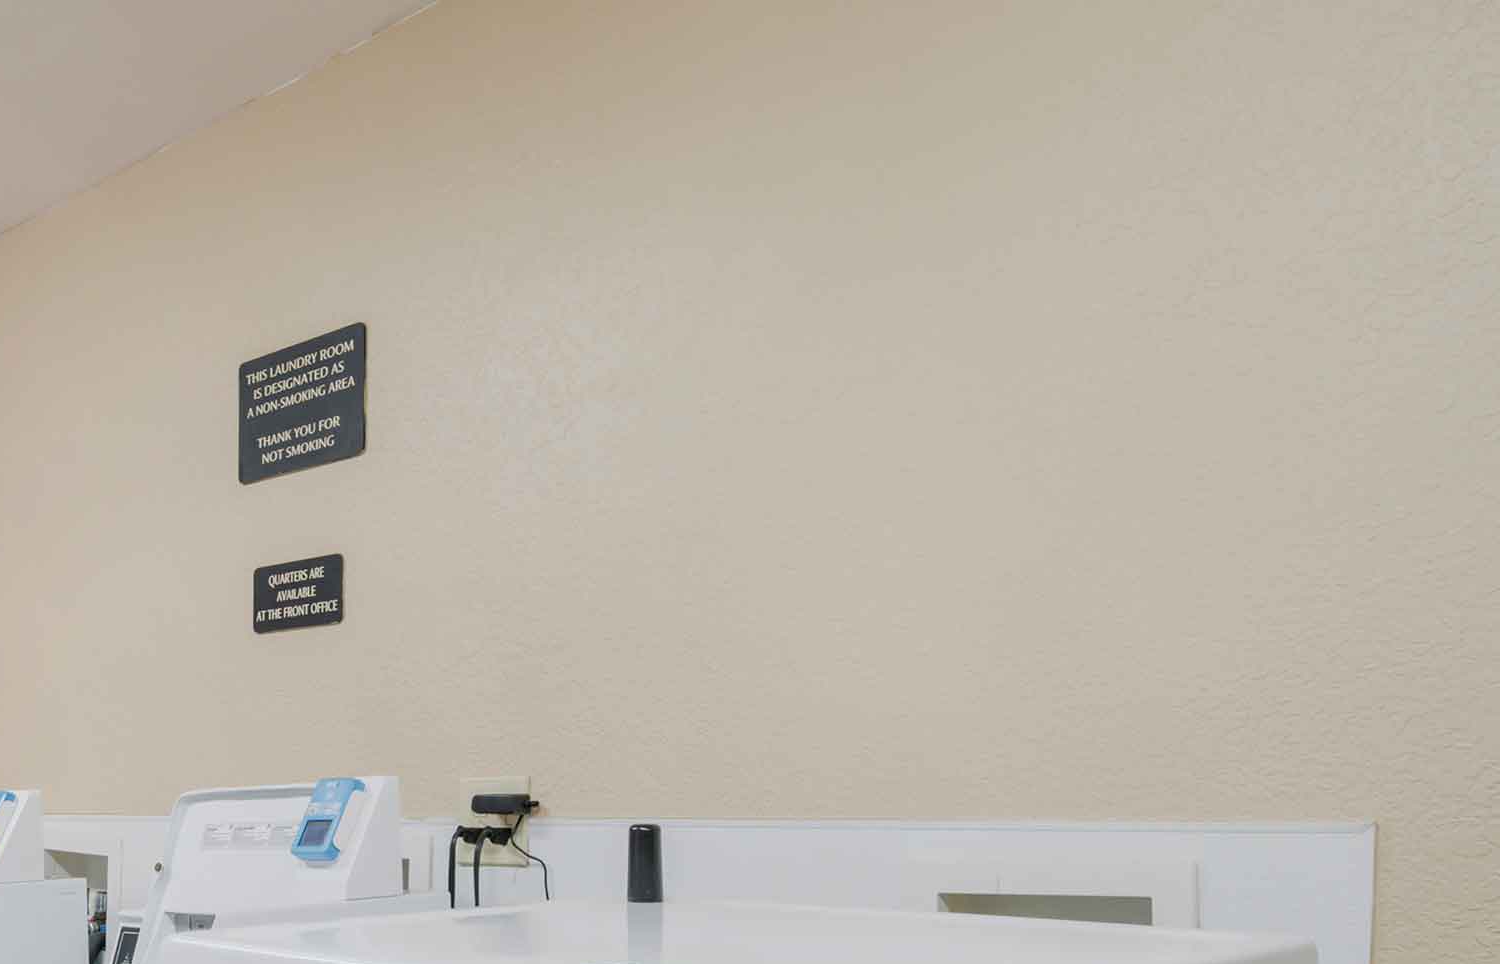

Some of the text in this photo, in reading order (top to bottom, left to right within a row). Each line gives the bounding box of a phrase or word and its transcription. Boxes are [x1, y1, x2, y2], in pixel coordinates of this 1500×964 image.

[246, 339, 353, 385] THIS LAUNDRY ROOM
[253, 360, 344, 400] IS DESIGNATED AS
[246, 375, 355, 418] A NON-SMOKING AREA
[257, 415, 340, 448] THANK YOU FOR
[261, 434, 334, 465] NOT SMOKING
[268, 566, 324, 587] QUARTERS ARE
[276, 585, 316, 602] AVAILABLE
[256, 598, 337, 622] AT THE FRONT OFFICE
